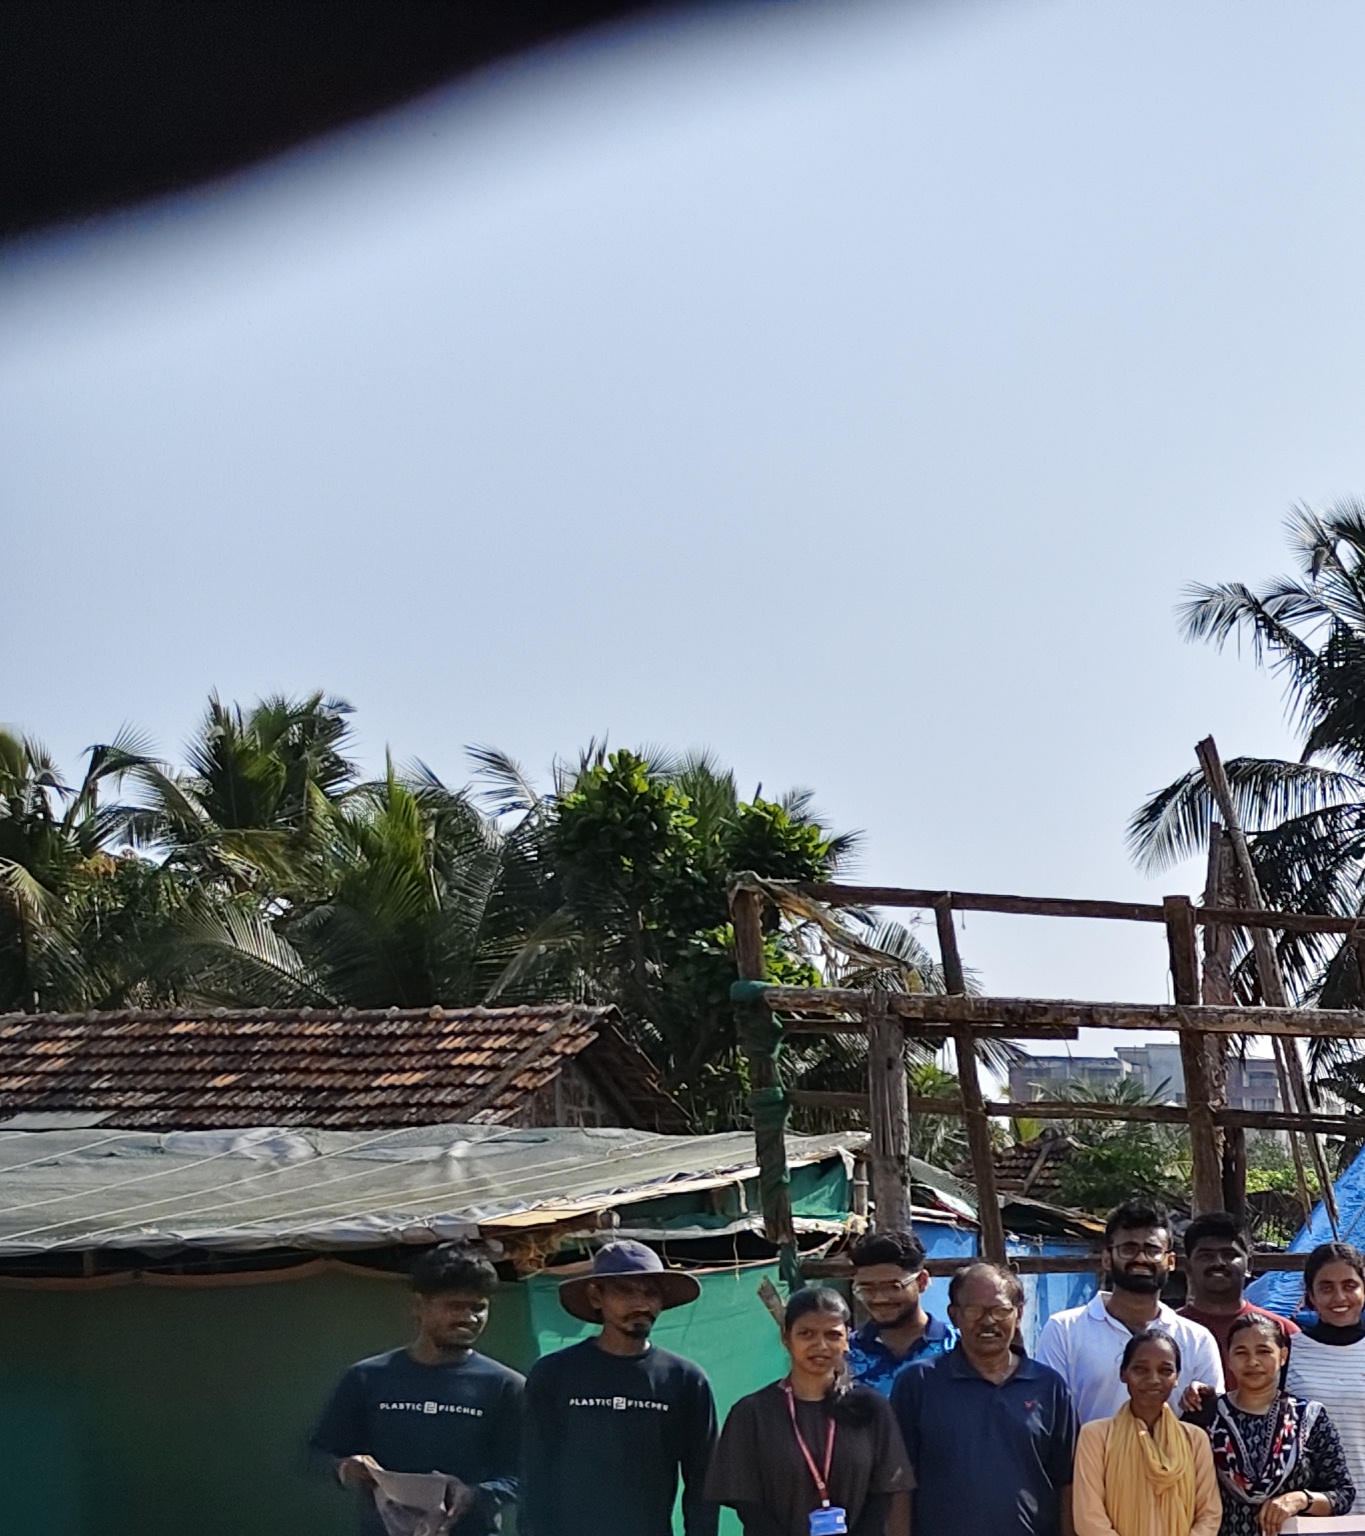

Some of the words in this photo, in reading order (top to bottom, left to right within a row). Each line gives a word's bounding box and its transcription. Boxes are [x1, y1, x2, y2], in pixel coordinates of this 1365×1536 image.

[380, 1402, 422, 1411] PLASTIC
[438, 1404, 484, 1416] FISCHER
[569, 1398, 612, 1407] PLASTIC
[627, 1400, 669, 1412] FISCHER
